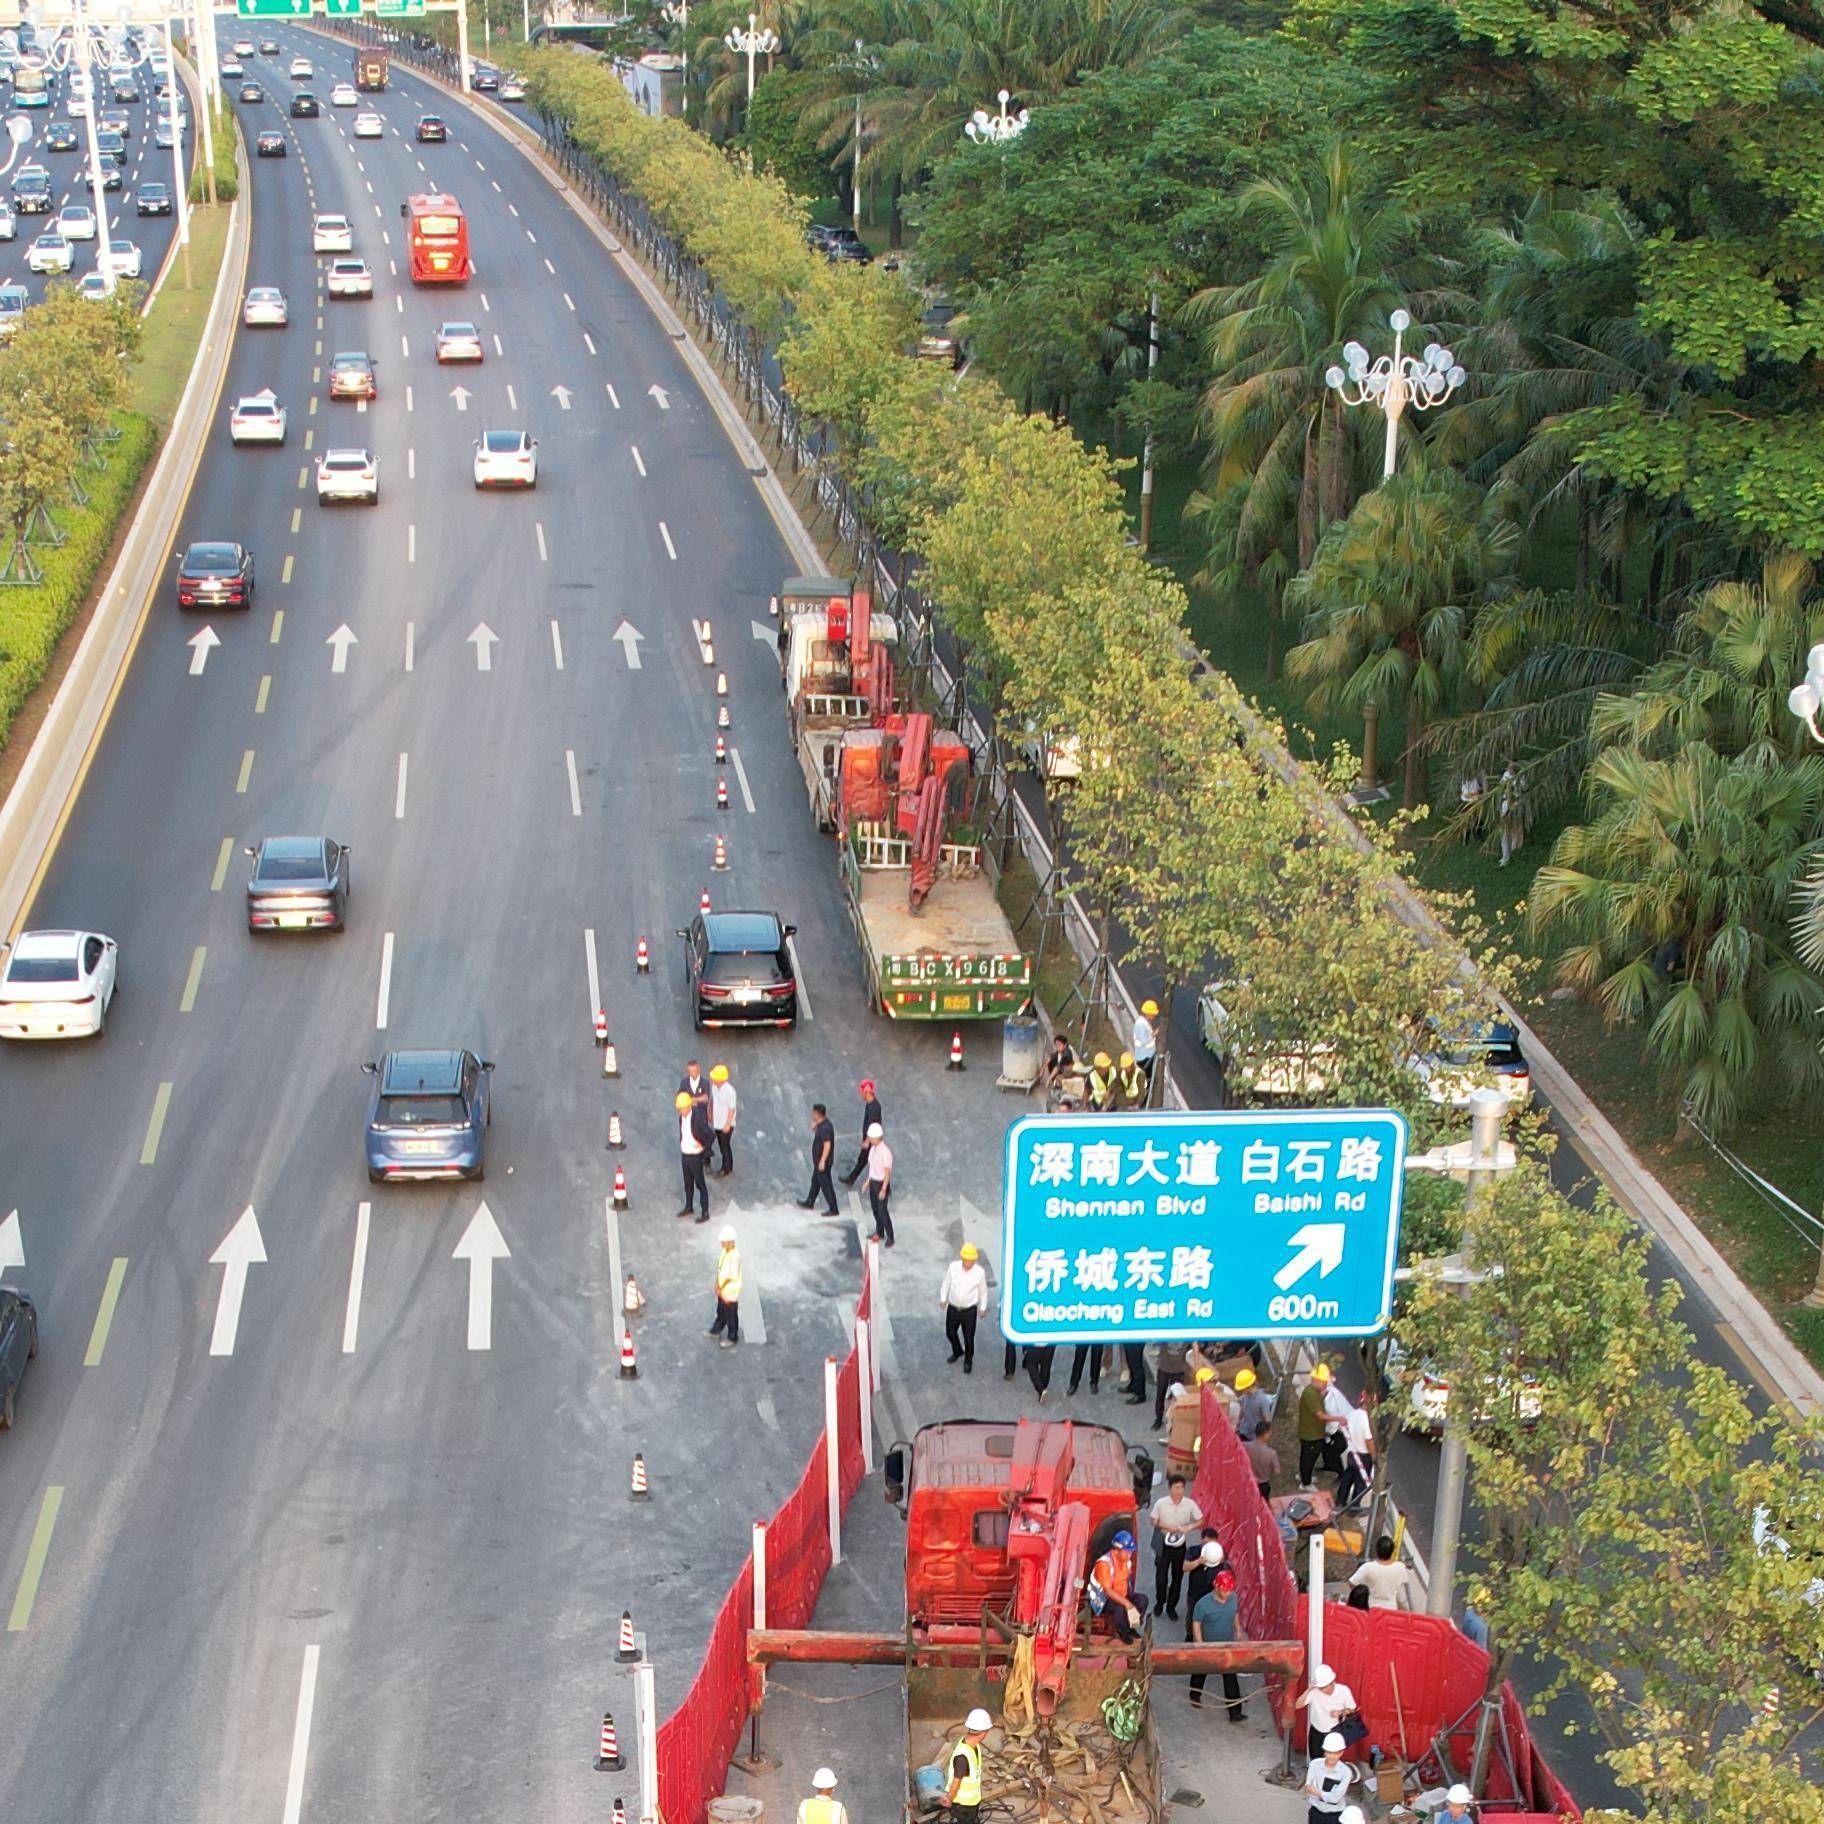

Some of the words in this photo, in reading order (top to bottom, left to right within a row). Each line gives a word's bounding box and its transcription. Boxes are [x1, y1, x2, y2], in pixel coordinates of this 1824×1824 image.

[1029, 1138, 1222, 1188] 深南大道
[1241, 1136, 1382, 1184] 白石路
[1045, 1197, 1145, 1218] Shennan
[1157, 1196, 1206, 1216] Blvd
[1254, 1192, 1322, 1213] Baishi
[1335, 1192, 1366, 1212] Rd
[1024, 1245, 1214, 1294] 侨城东路
[1023, 1300, 1123, 1324] Qiaocheng
[1134, 1299, 1175, 1320] East
[1186, 1299, 1213, 1318] Rd
[1268, 1294, 1339, 1321] 600m
